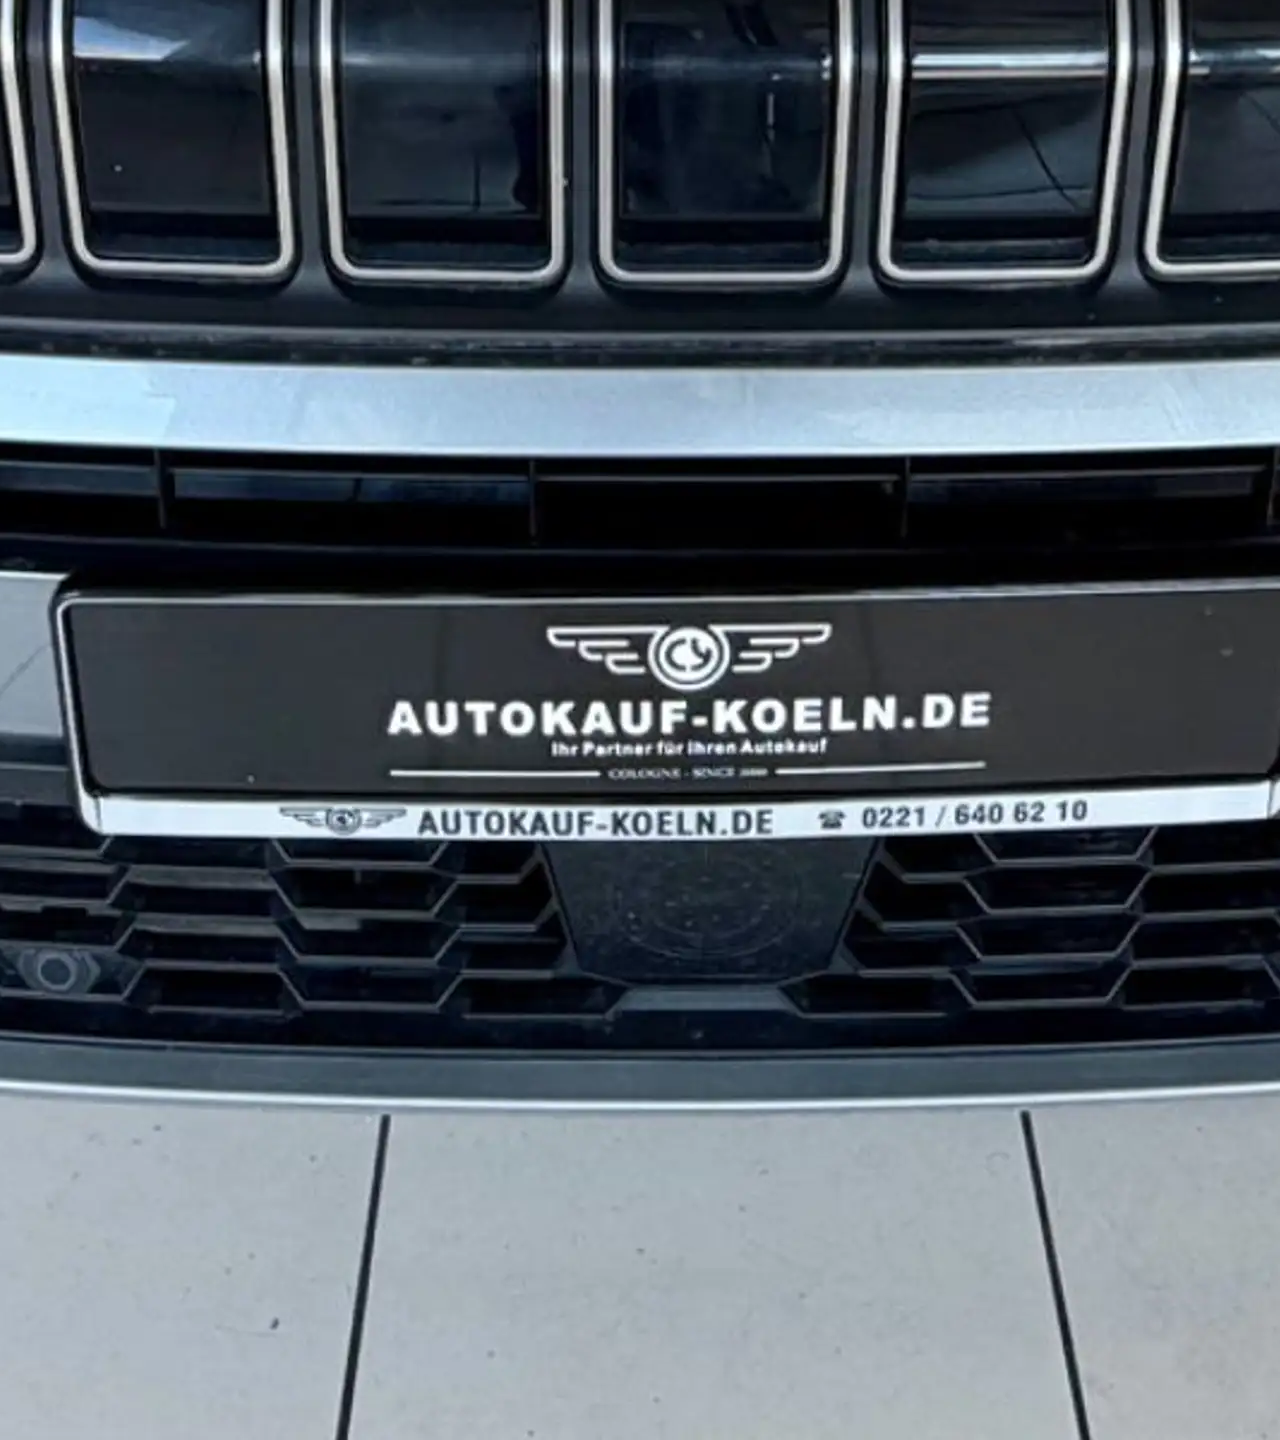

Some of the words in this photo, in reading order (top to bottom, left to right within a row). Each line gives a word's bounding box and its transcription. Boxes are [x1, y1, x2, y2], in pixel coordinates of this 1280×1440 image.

[387, 691, 992, 737] AUTOKAUF-KOELN.DE
[550, 740, 578, 757] Ihr
[581, 740, 653, 757] Partner
[656, 740, 685, 756] für
[687, 739, 737, 755] Ihren
[739, 737, 828, 754] Autokauf
[417, 808, 773, 837] AUTOKAUF-KOELN.DE
[861, 806, 925, 829] 0221
[953, 802, 1004, 825] 640
[1013, 801, 1045, 823] 62
[1056, 799, 1088, 821] 10
